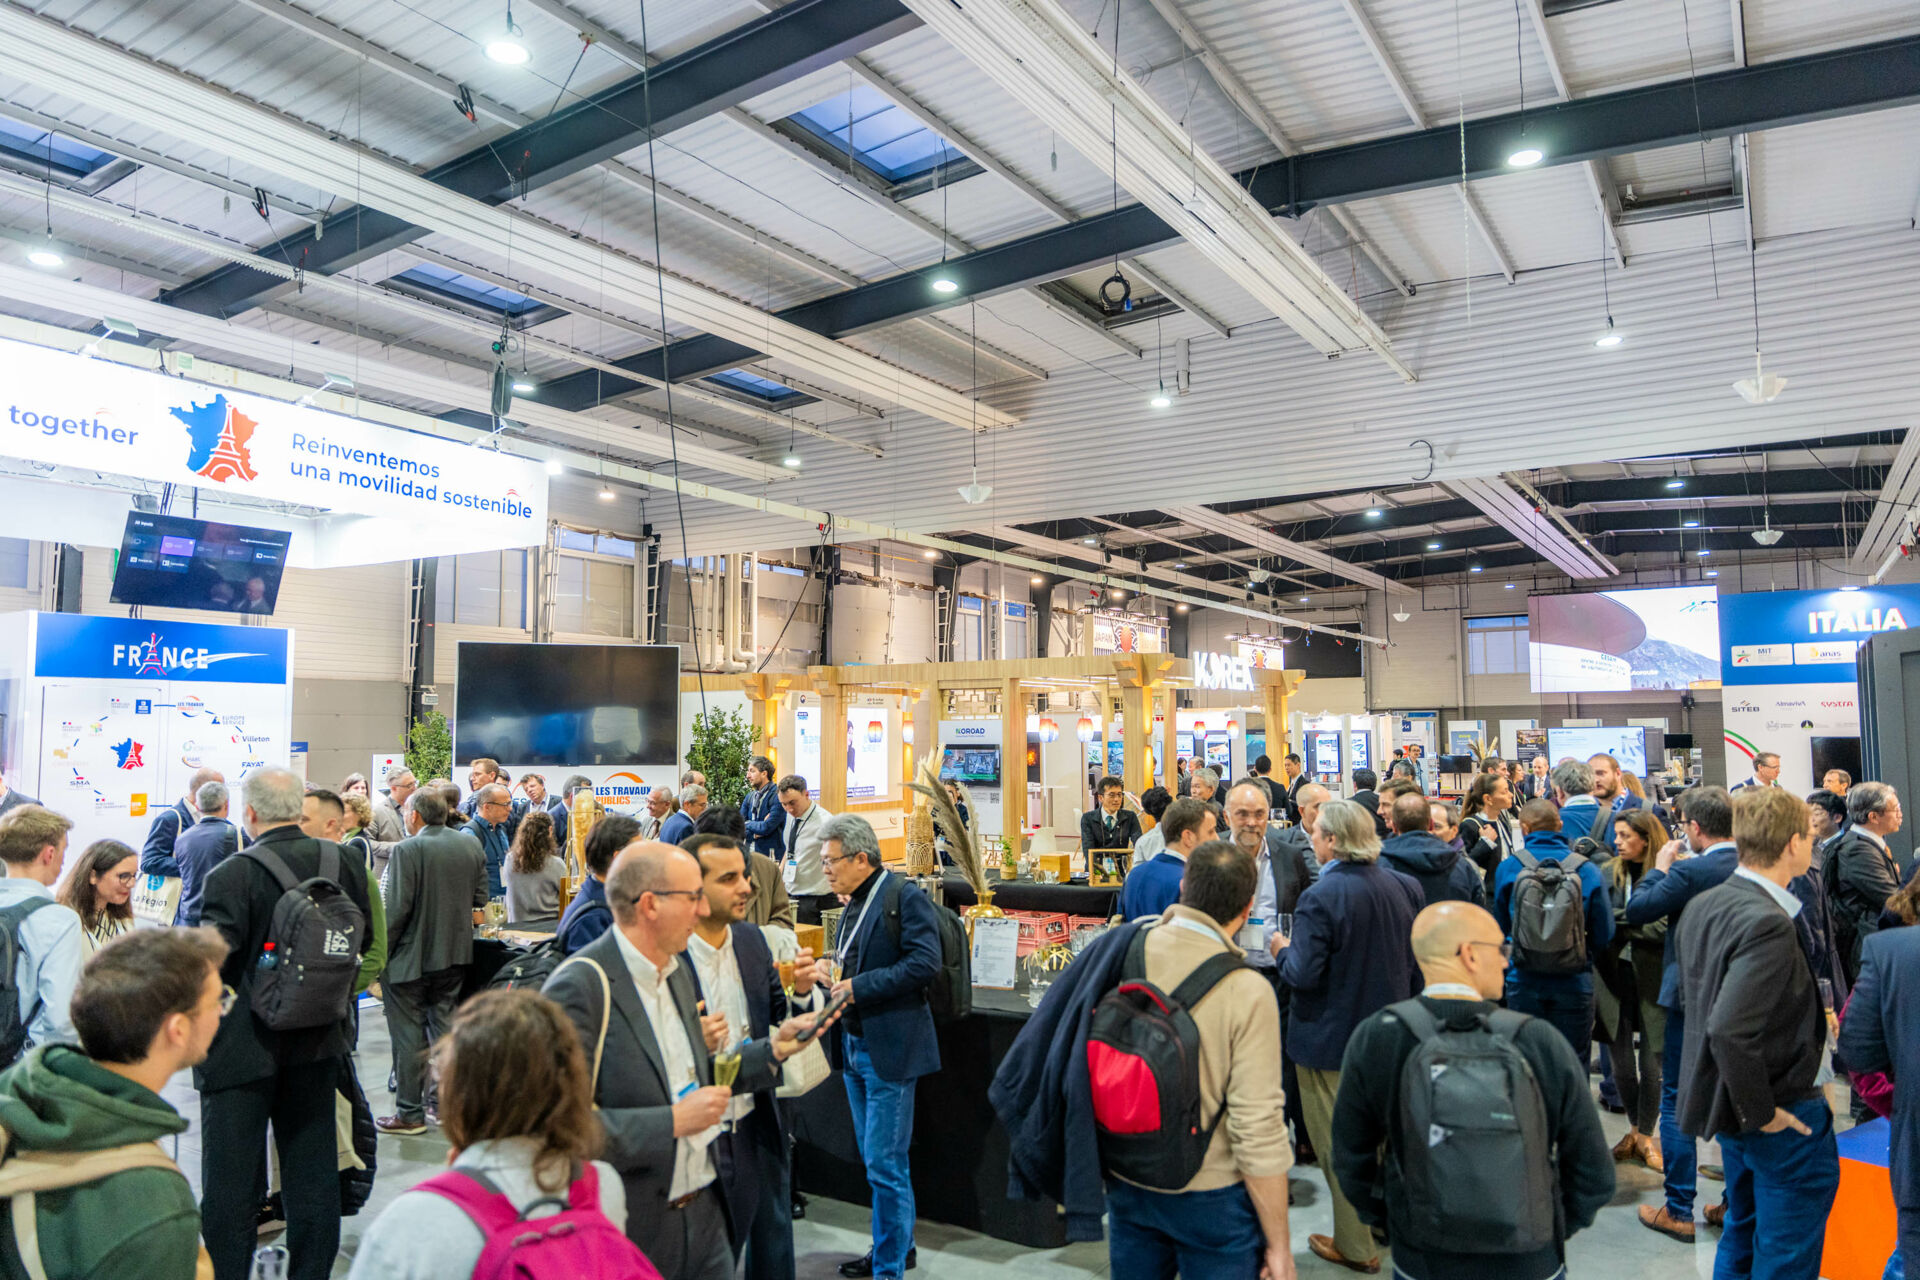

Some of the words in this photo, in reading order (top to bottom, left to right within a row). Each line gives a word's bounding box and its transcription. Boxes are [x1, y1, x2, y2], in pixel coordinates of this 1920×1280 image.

[9, 403, 139, 446] together
[291, 433, 441, 479] Reinventemos
[290, 460, 331, 484] una
[338, 469, 438, 501] movilidad
[442, 490, 533, 519] sostenible
[1808, 607, 1908, 634] ITALIA
[113, 637, 209, 674] FRANCE
[1193, 651, 1255, 692] KOREA
[242, 735, 270, 743] Villeton
[596, 786, 610, 796] LES
[612, 786, 652, 796] TRAVAUX
[596, 796, 631, 805] PUBLICS
